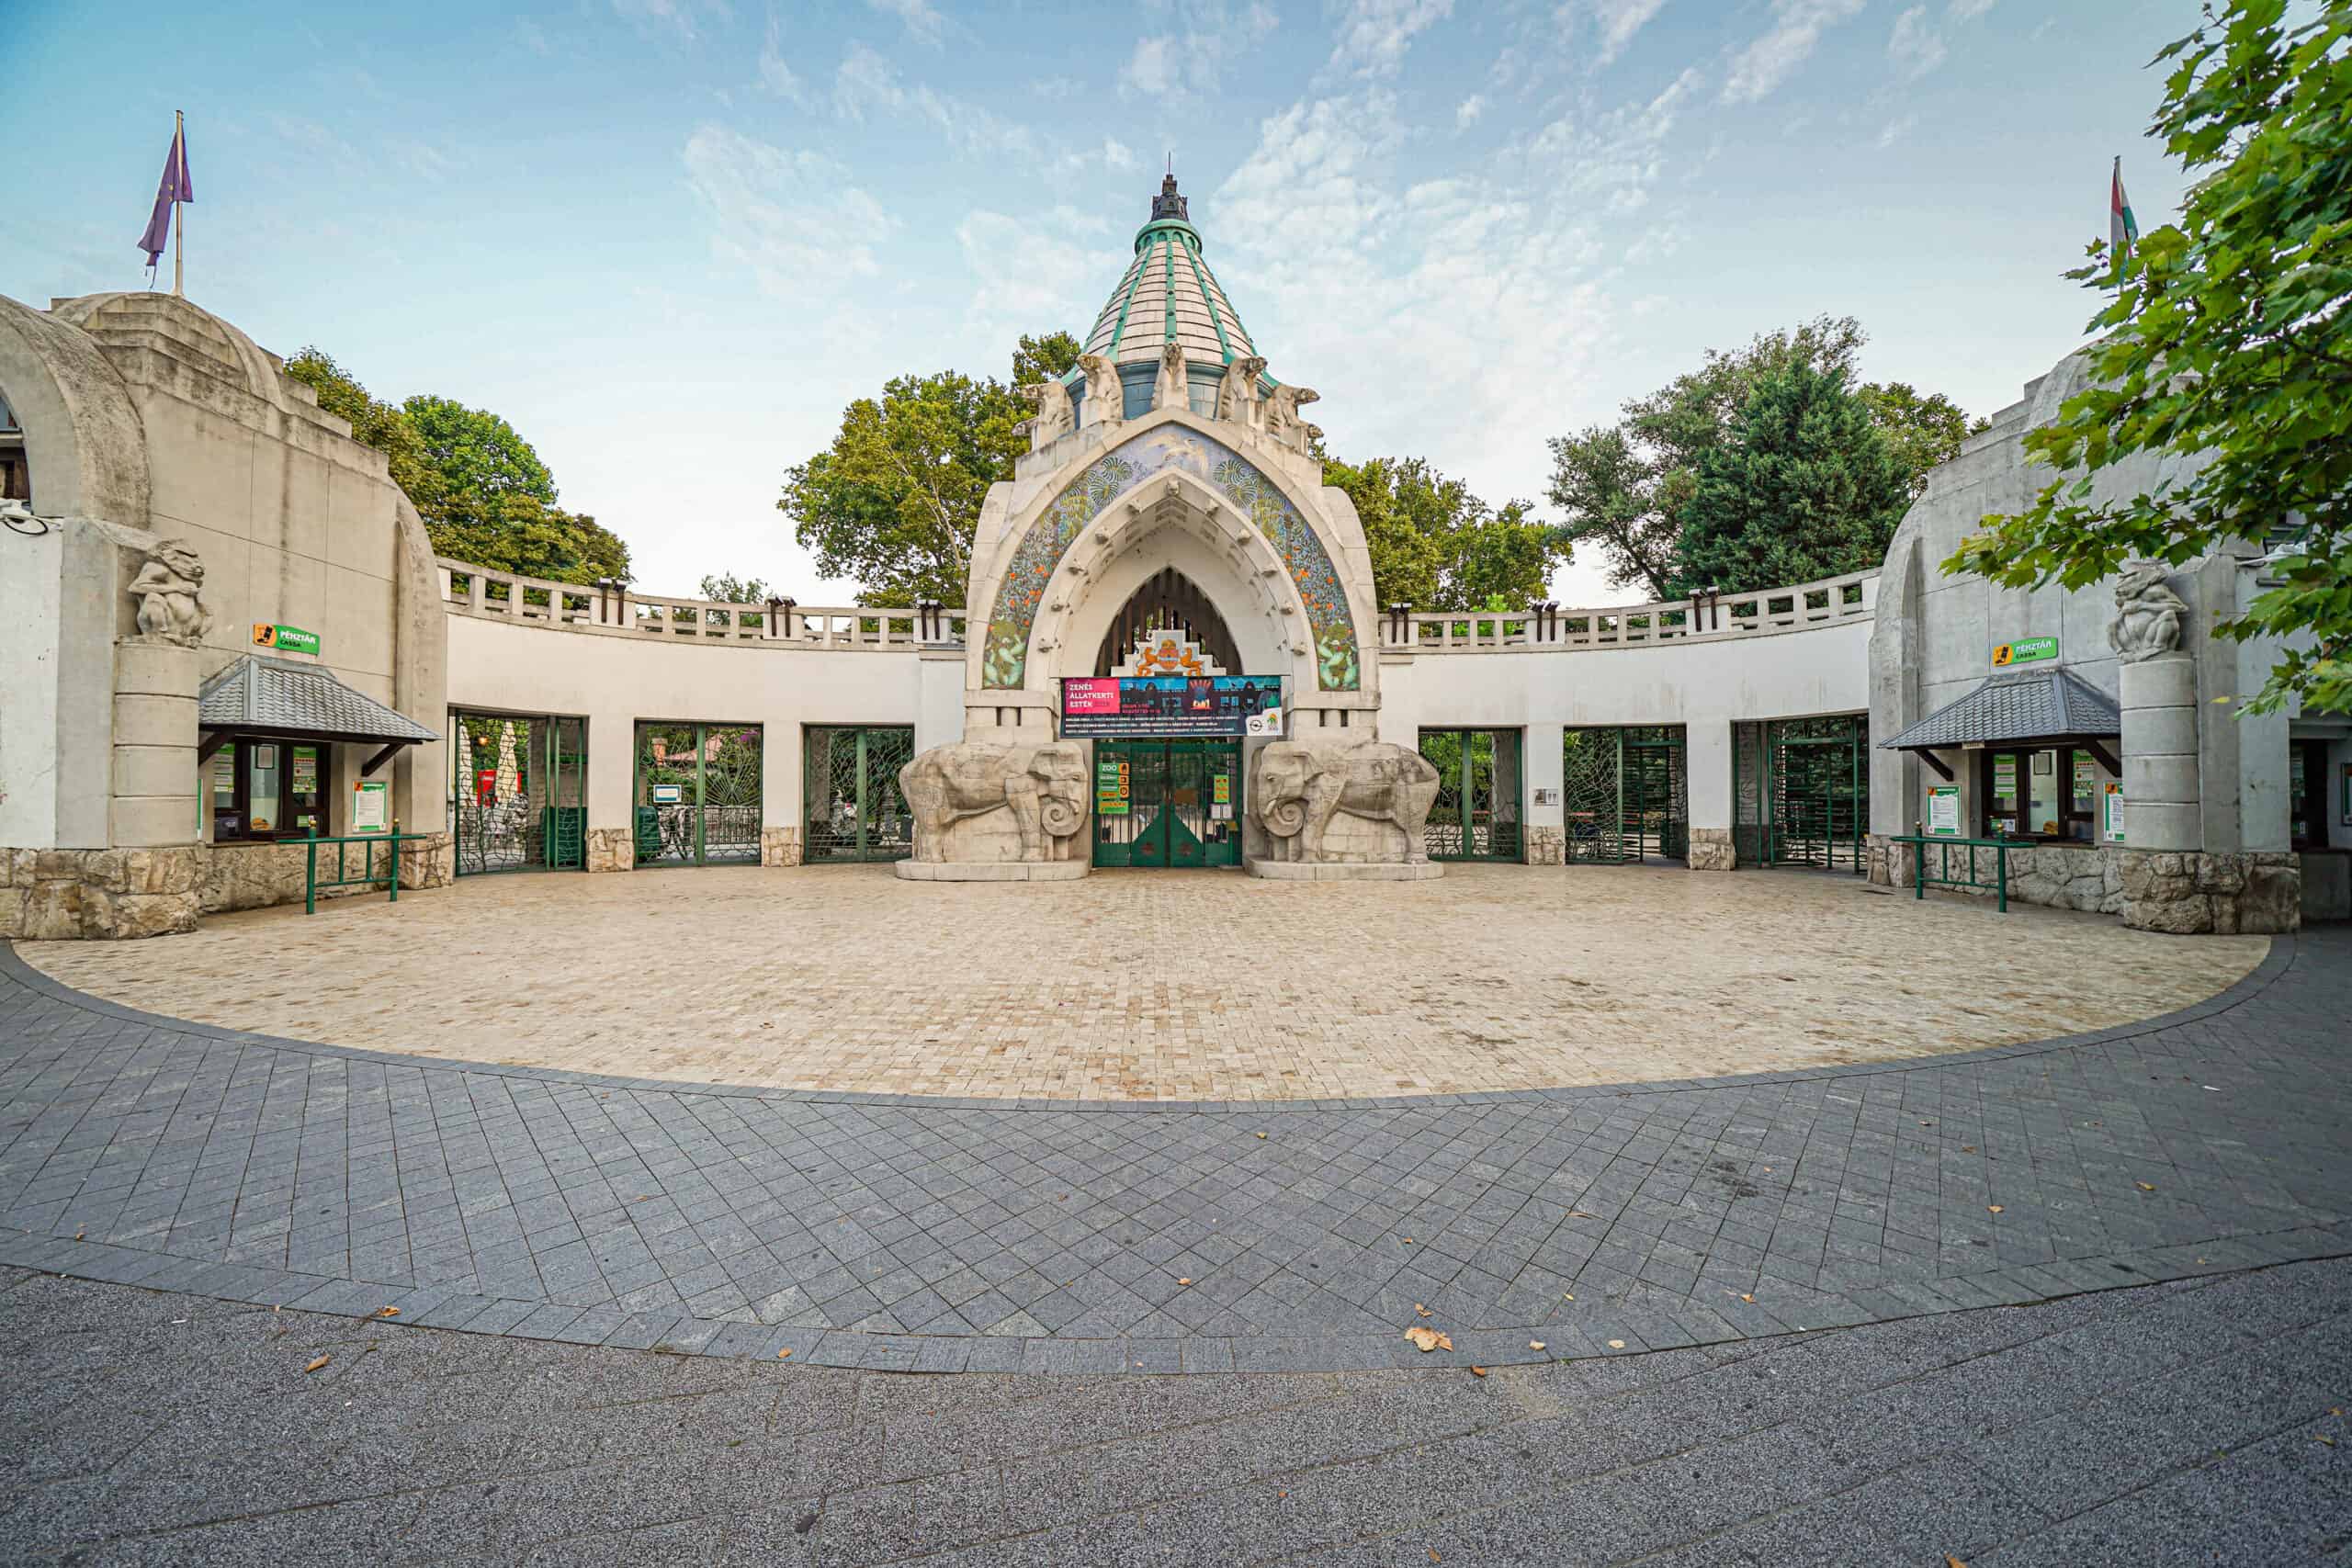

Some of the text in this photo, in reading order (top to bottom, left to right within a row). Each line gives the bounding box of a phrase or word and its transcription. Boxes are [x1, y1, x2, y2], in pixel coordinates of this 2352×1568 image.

[279, 630, 317, 645] PÉNZTÁR
[2016, 640, 2052, 653] PÉNZTÁR
[1069, 682, 1093, 691] ZENÉS
